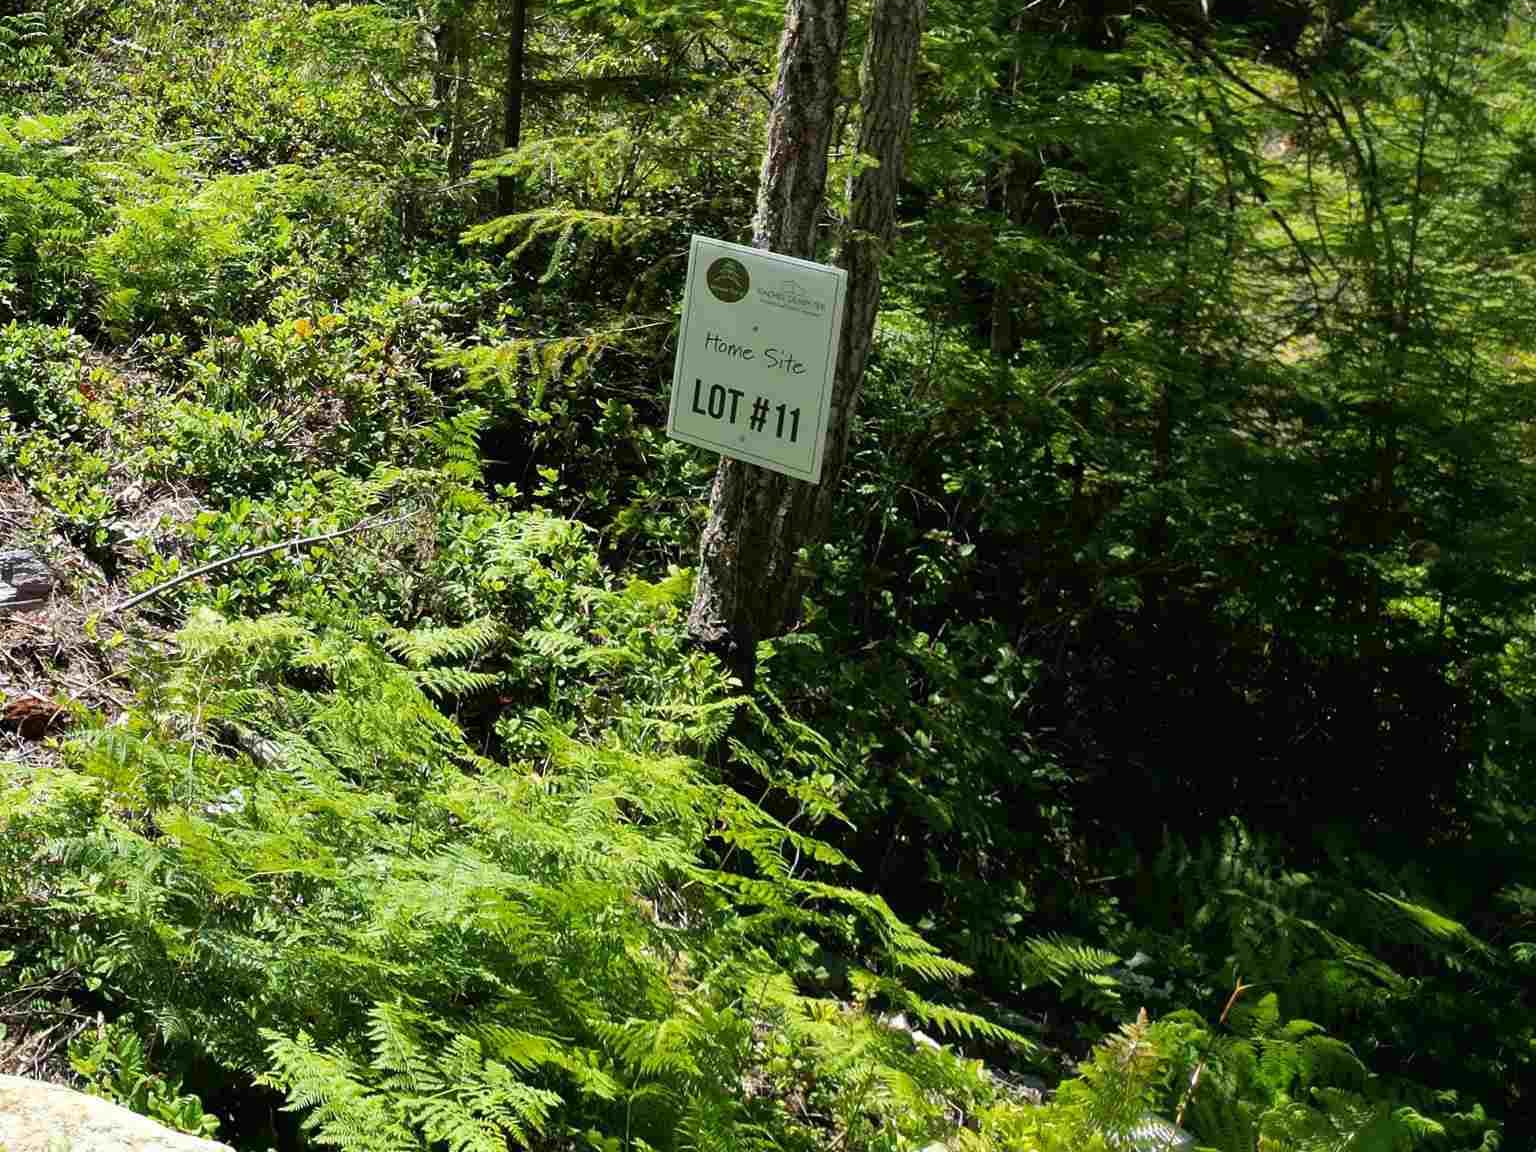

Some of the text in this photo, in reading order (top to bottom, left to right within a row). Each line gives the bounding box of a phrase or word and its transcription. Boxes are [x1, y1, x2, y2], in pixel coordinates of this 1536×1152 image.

[705, 332, 807, 375] Home Site
[692, 379, 800, 443] LOT #11
